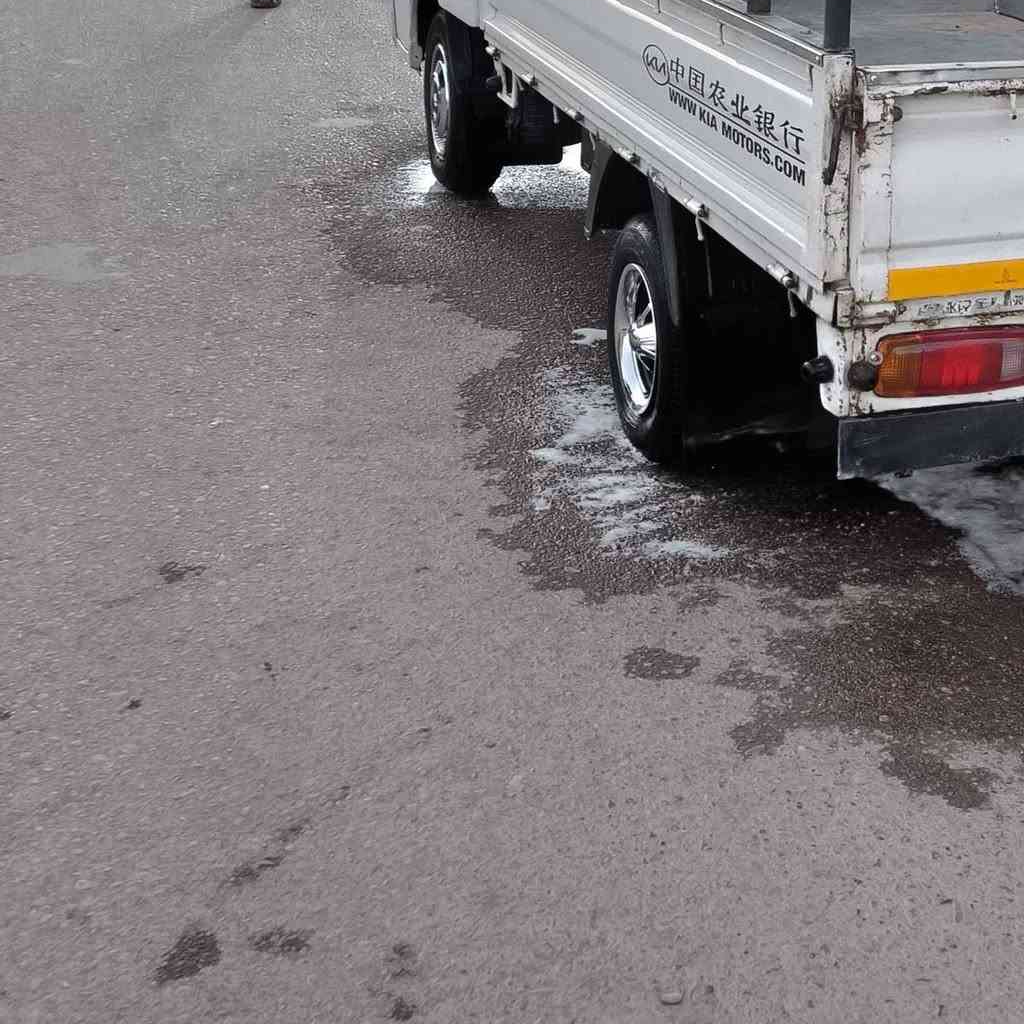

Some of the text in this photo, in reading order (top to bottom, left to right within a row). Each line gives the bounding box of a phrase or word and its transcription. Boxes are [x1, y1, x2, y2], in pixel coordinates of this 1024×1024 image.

[669, 56, 806, 156] 中国农业银行
[698, 108, 718, 132] KIA
[721, 122, 806, 187] MOTORS.COM
